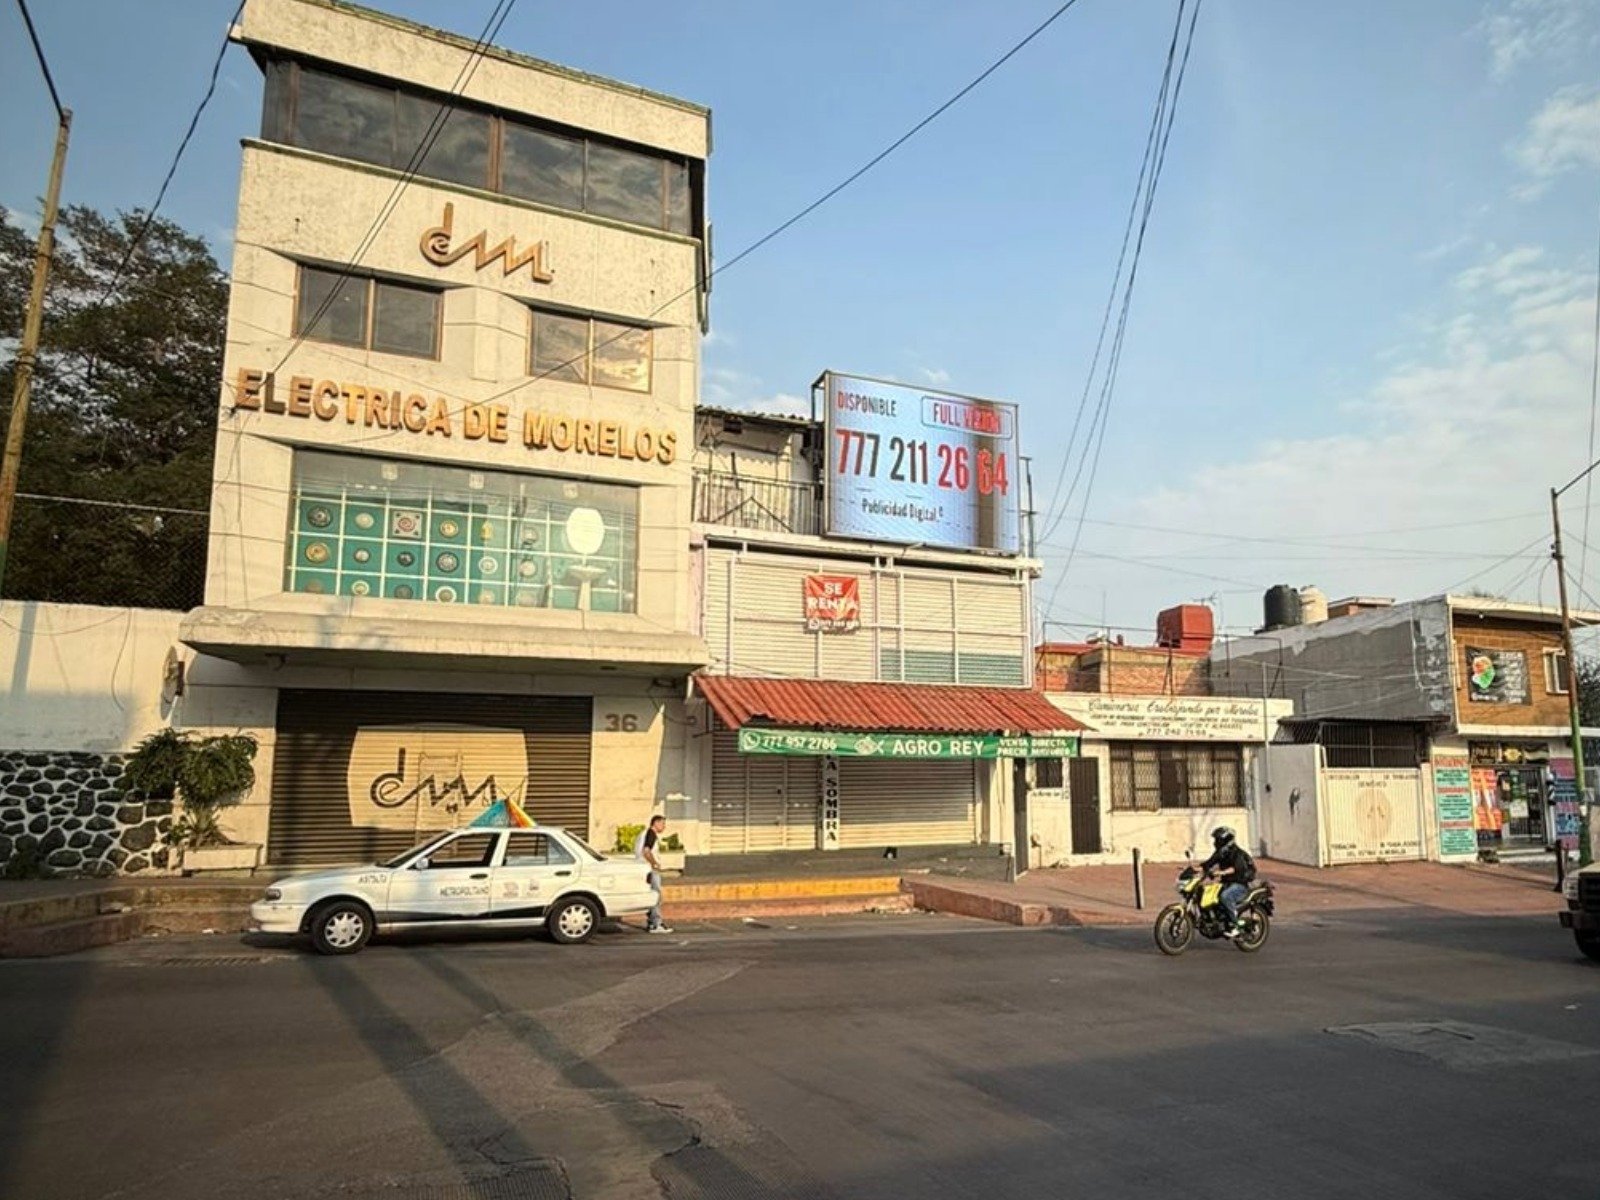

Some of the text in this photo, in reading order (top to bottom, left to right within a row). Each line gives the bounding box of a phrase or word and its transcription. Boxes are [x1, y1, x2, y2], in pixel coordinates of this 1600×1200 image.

[236, 367, 677, 465] ELECTRICA DE MORELOS
[838, 391, 897, 418] DISPONIBLE
[933, 402, 961, 427] FULL
[836, 428, 1010, 496] 777 211 26 64
[861, 498, 908, 517] Publicidad
[823, 582, 844, 596] SE
[604, 713, 638, 732] 36
[892, 739, 985, 757] AGRO REY
